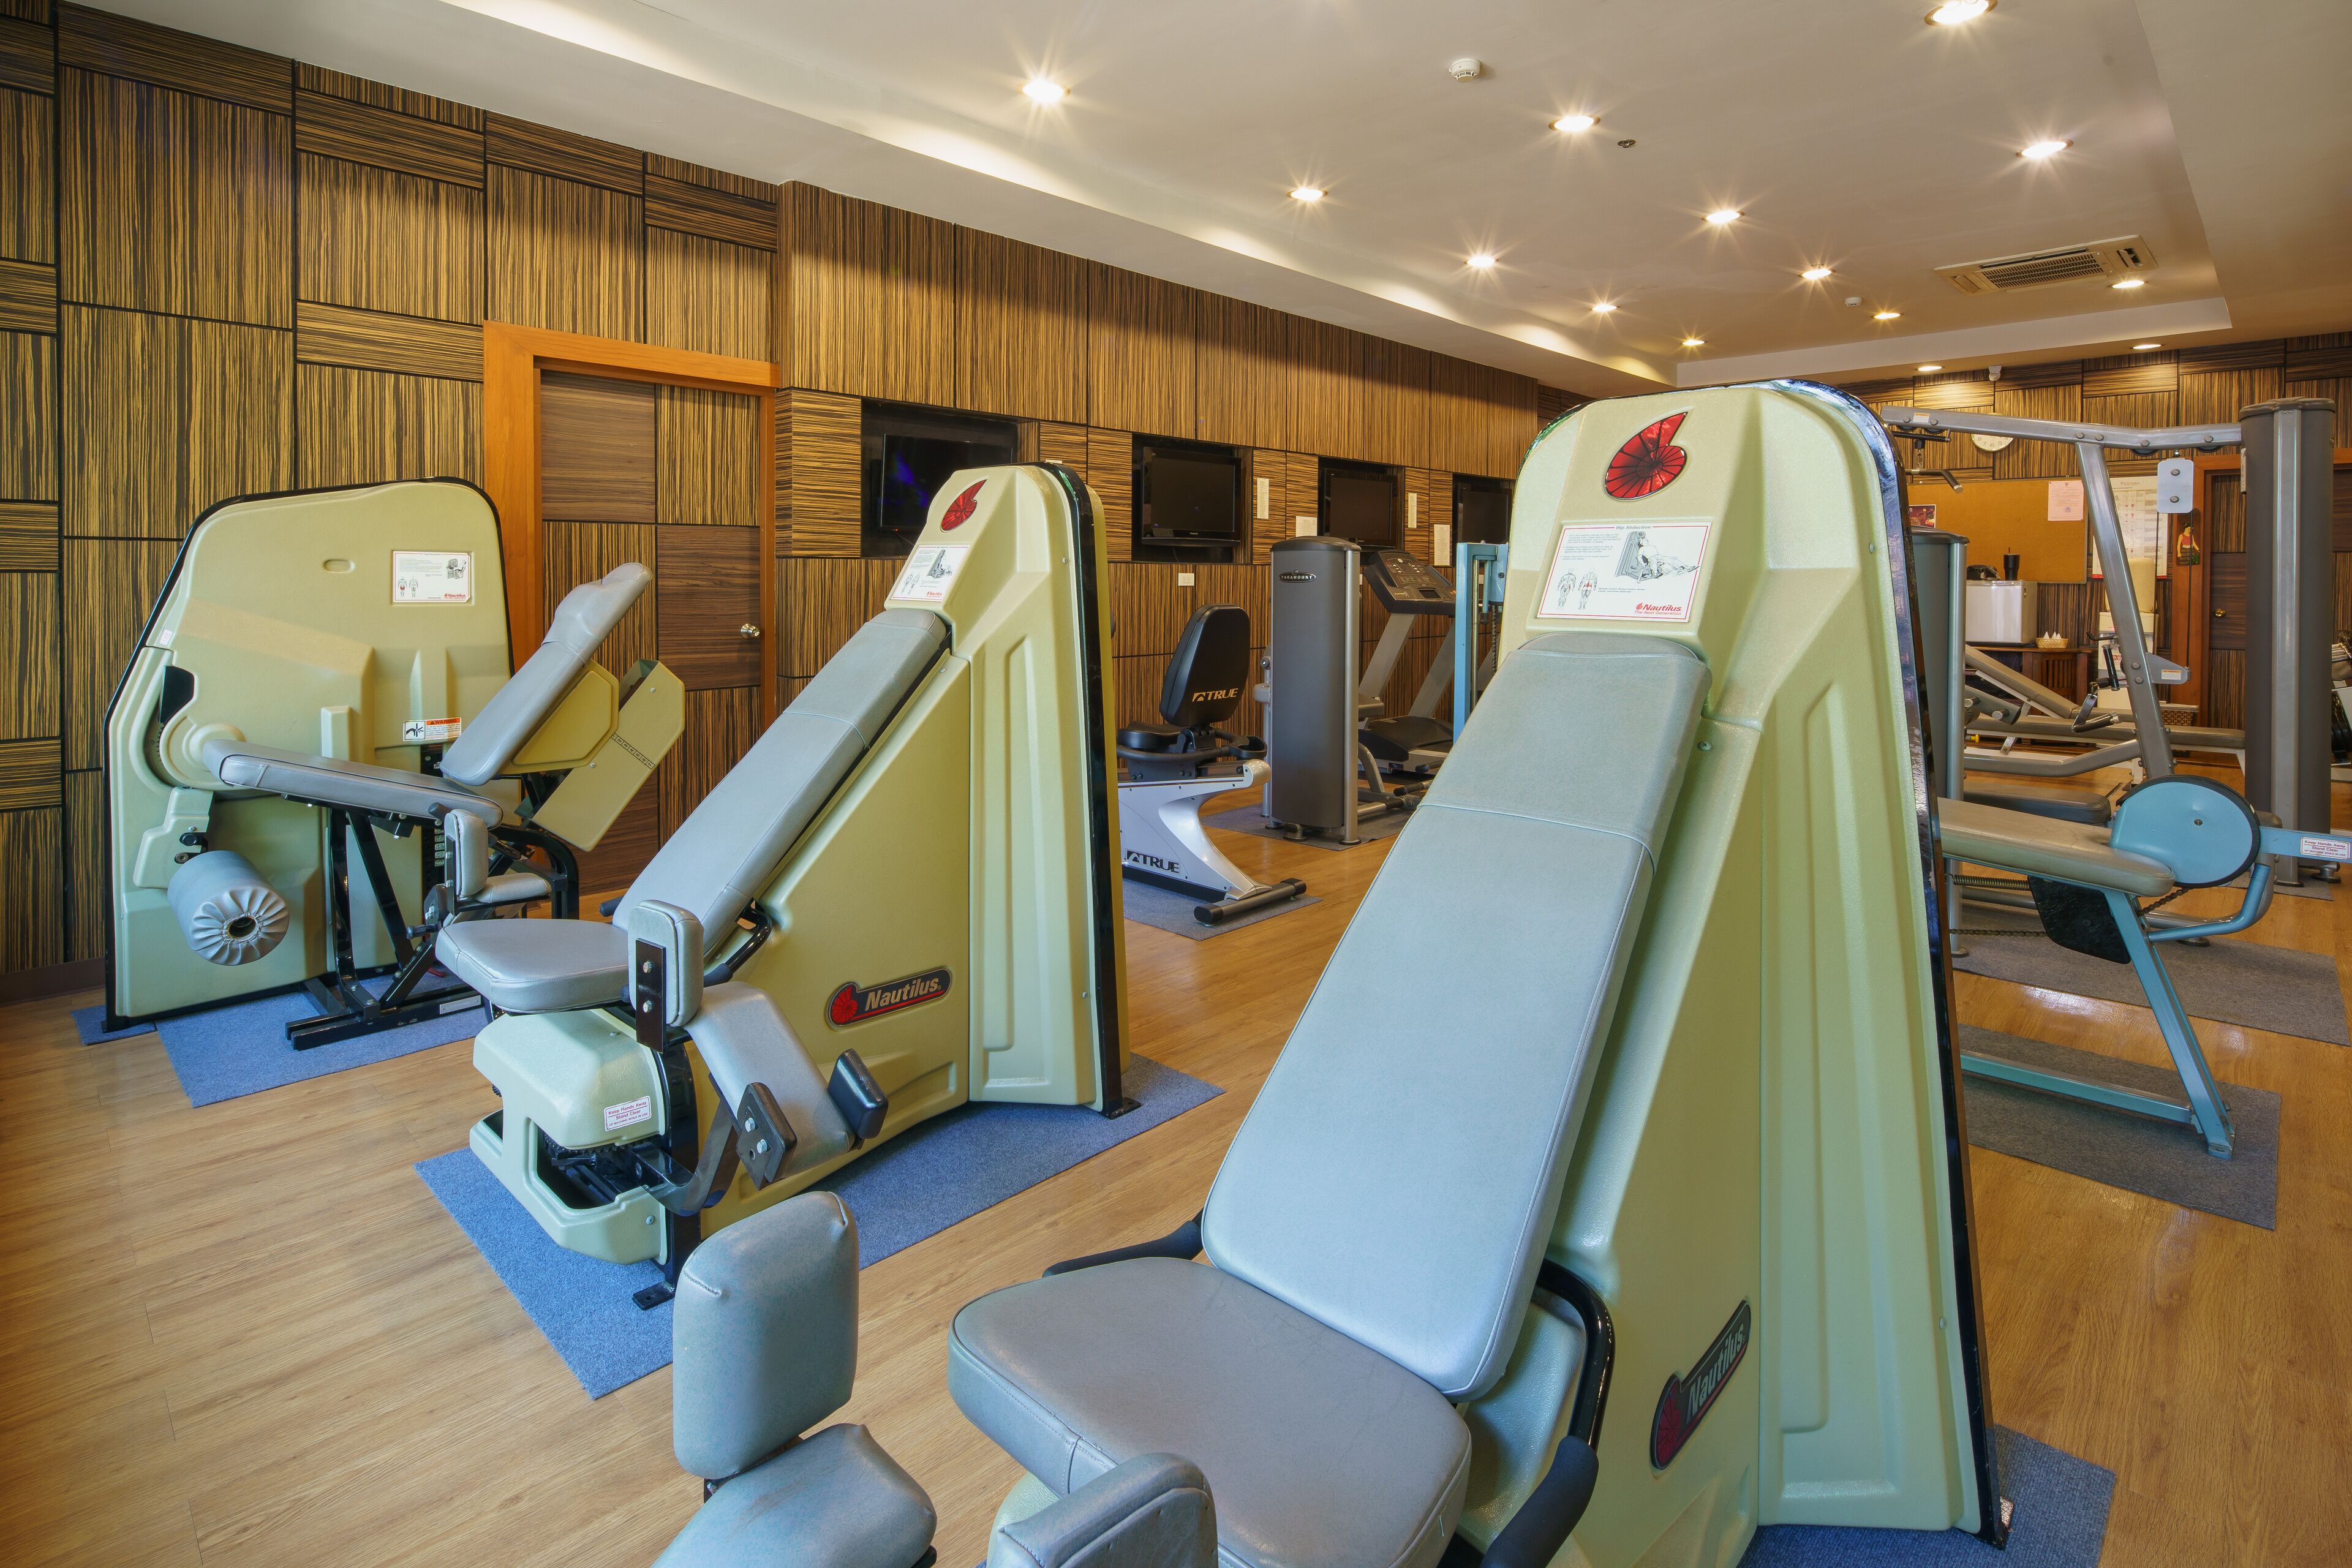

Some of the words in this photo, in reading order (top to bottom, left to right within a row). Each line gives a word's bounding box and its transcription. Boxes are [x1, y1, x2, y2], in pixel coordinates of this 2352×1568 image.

[1207, 688, 1238, 700] TRUE
[1140, 854, 1179, 873] TRUE
[865, 978, 940, 1011] Nautilus
[1686, 1323, 1744, 1424] Nautilus
